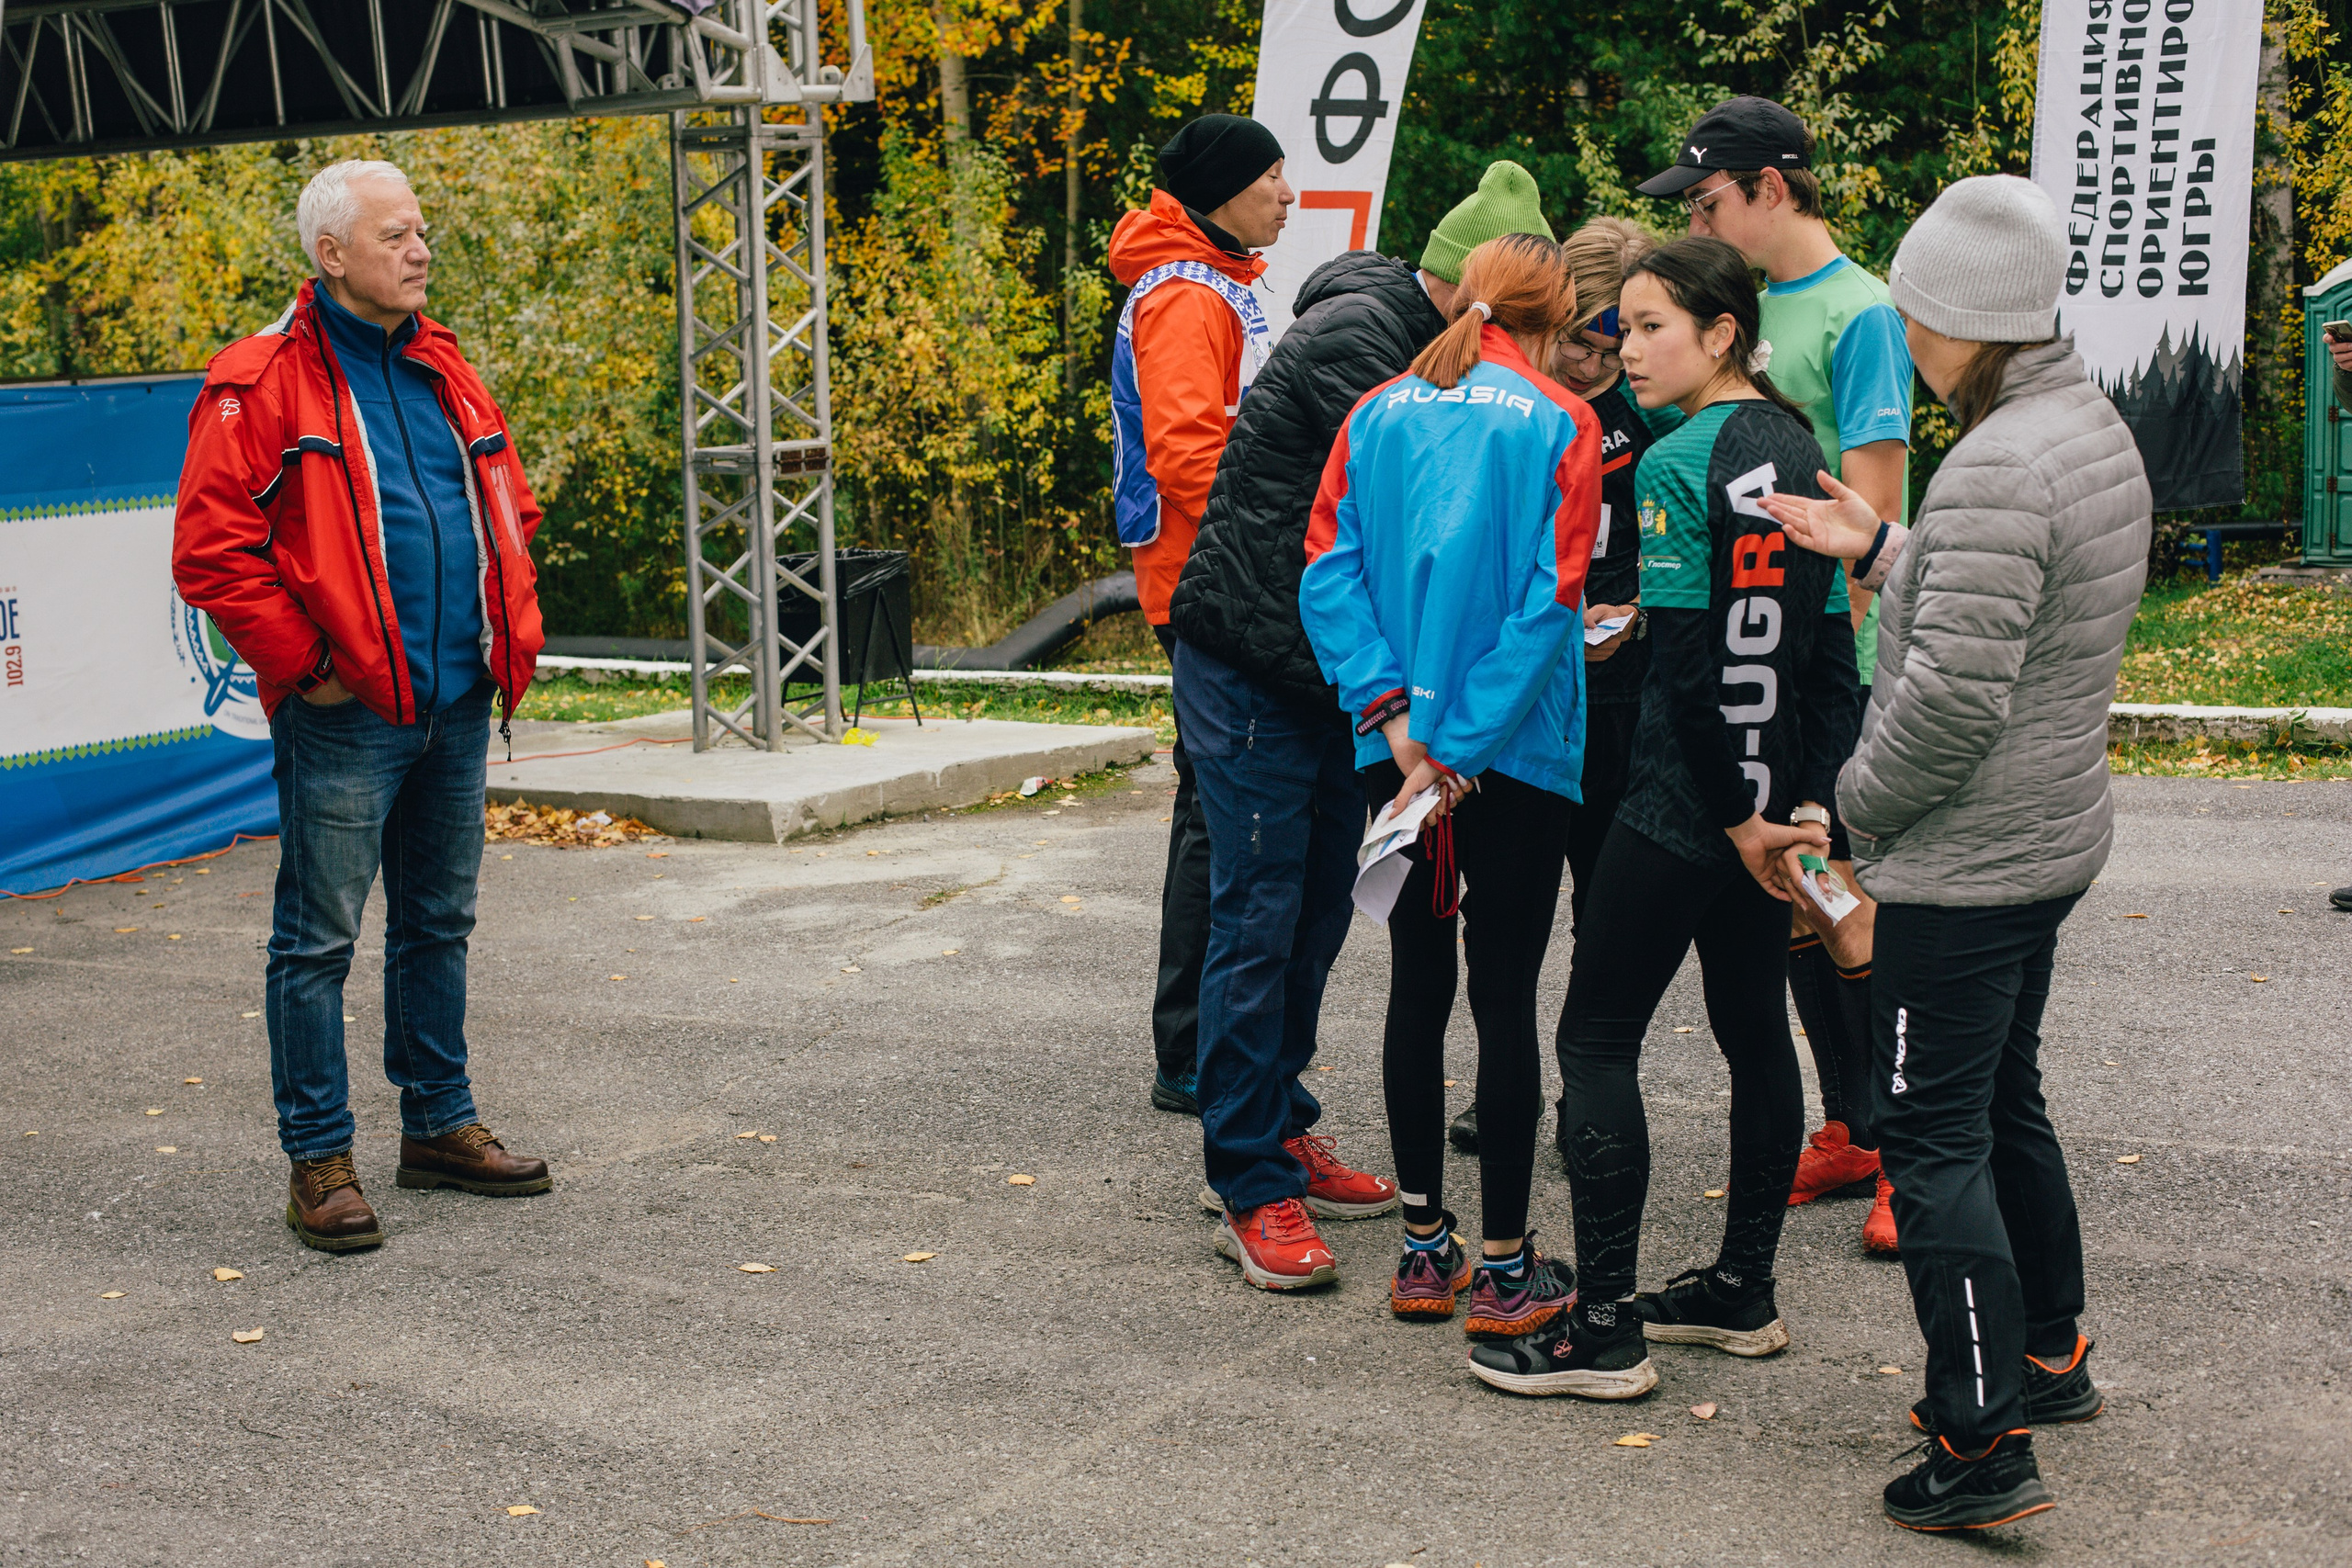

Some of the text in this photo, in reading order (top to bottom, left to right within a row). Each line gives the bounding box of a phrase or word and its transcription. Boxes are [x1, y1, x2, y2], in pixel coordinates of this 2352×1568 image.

[2065, 0, 2112, 296] ФЕДЕРАЦИЯ
[2100, 0, 2151, 299] СПОРТИВНО
[2136, 0, 2194, 299] ОРИЕНТИРО
[2177, 138, 2216, 296] ЮГРЫ
[1387, 385, 1535, 418] RUSSIA
[5, 646, 24, 687] 102.9
